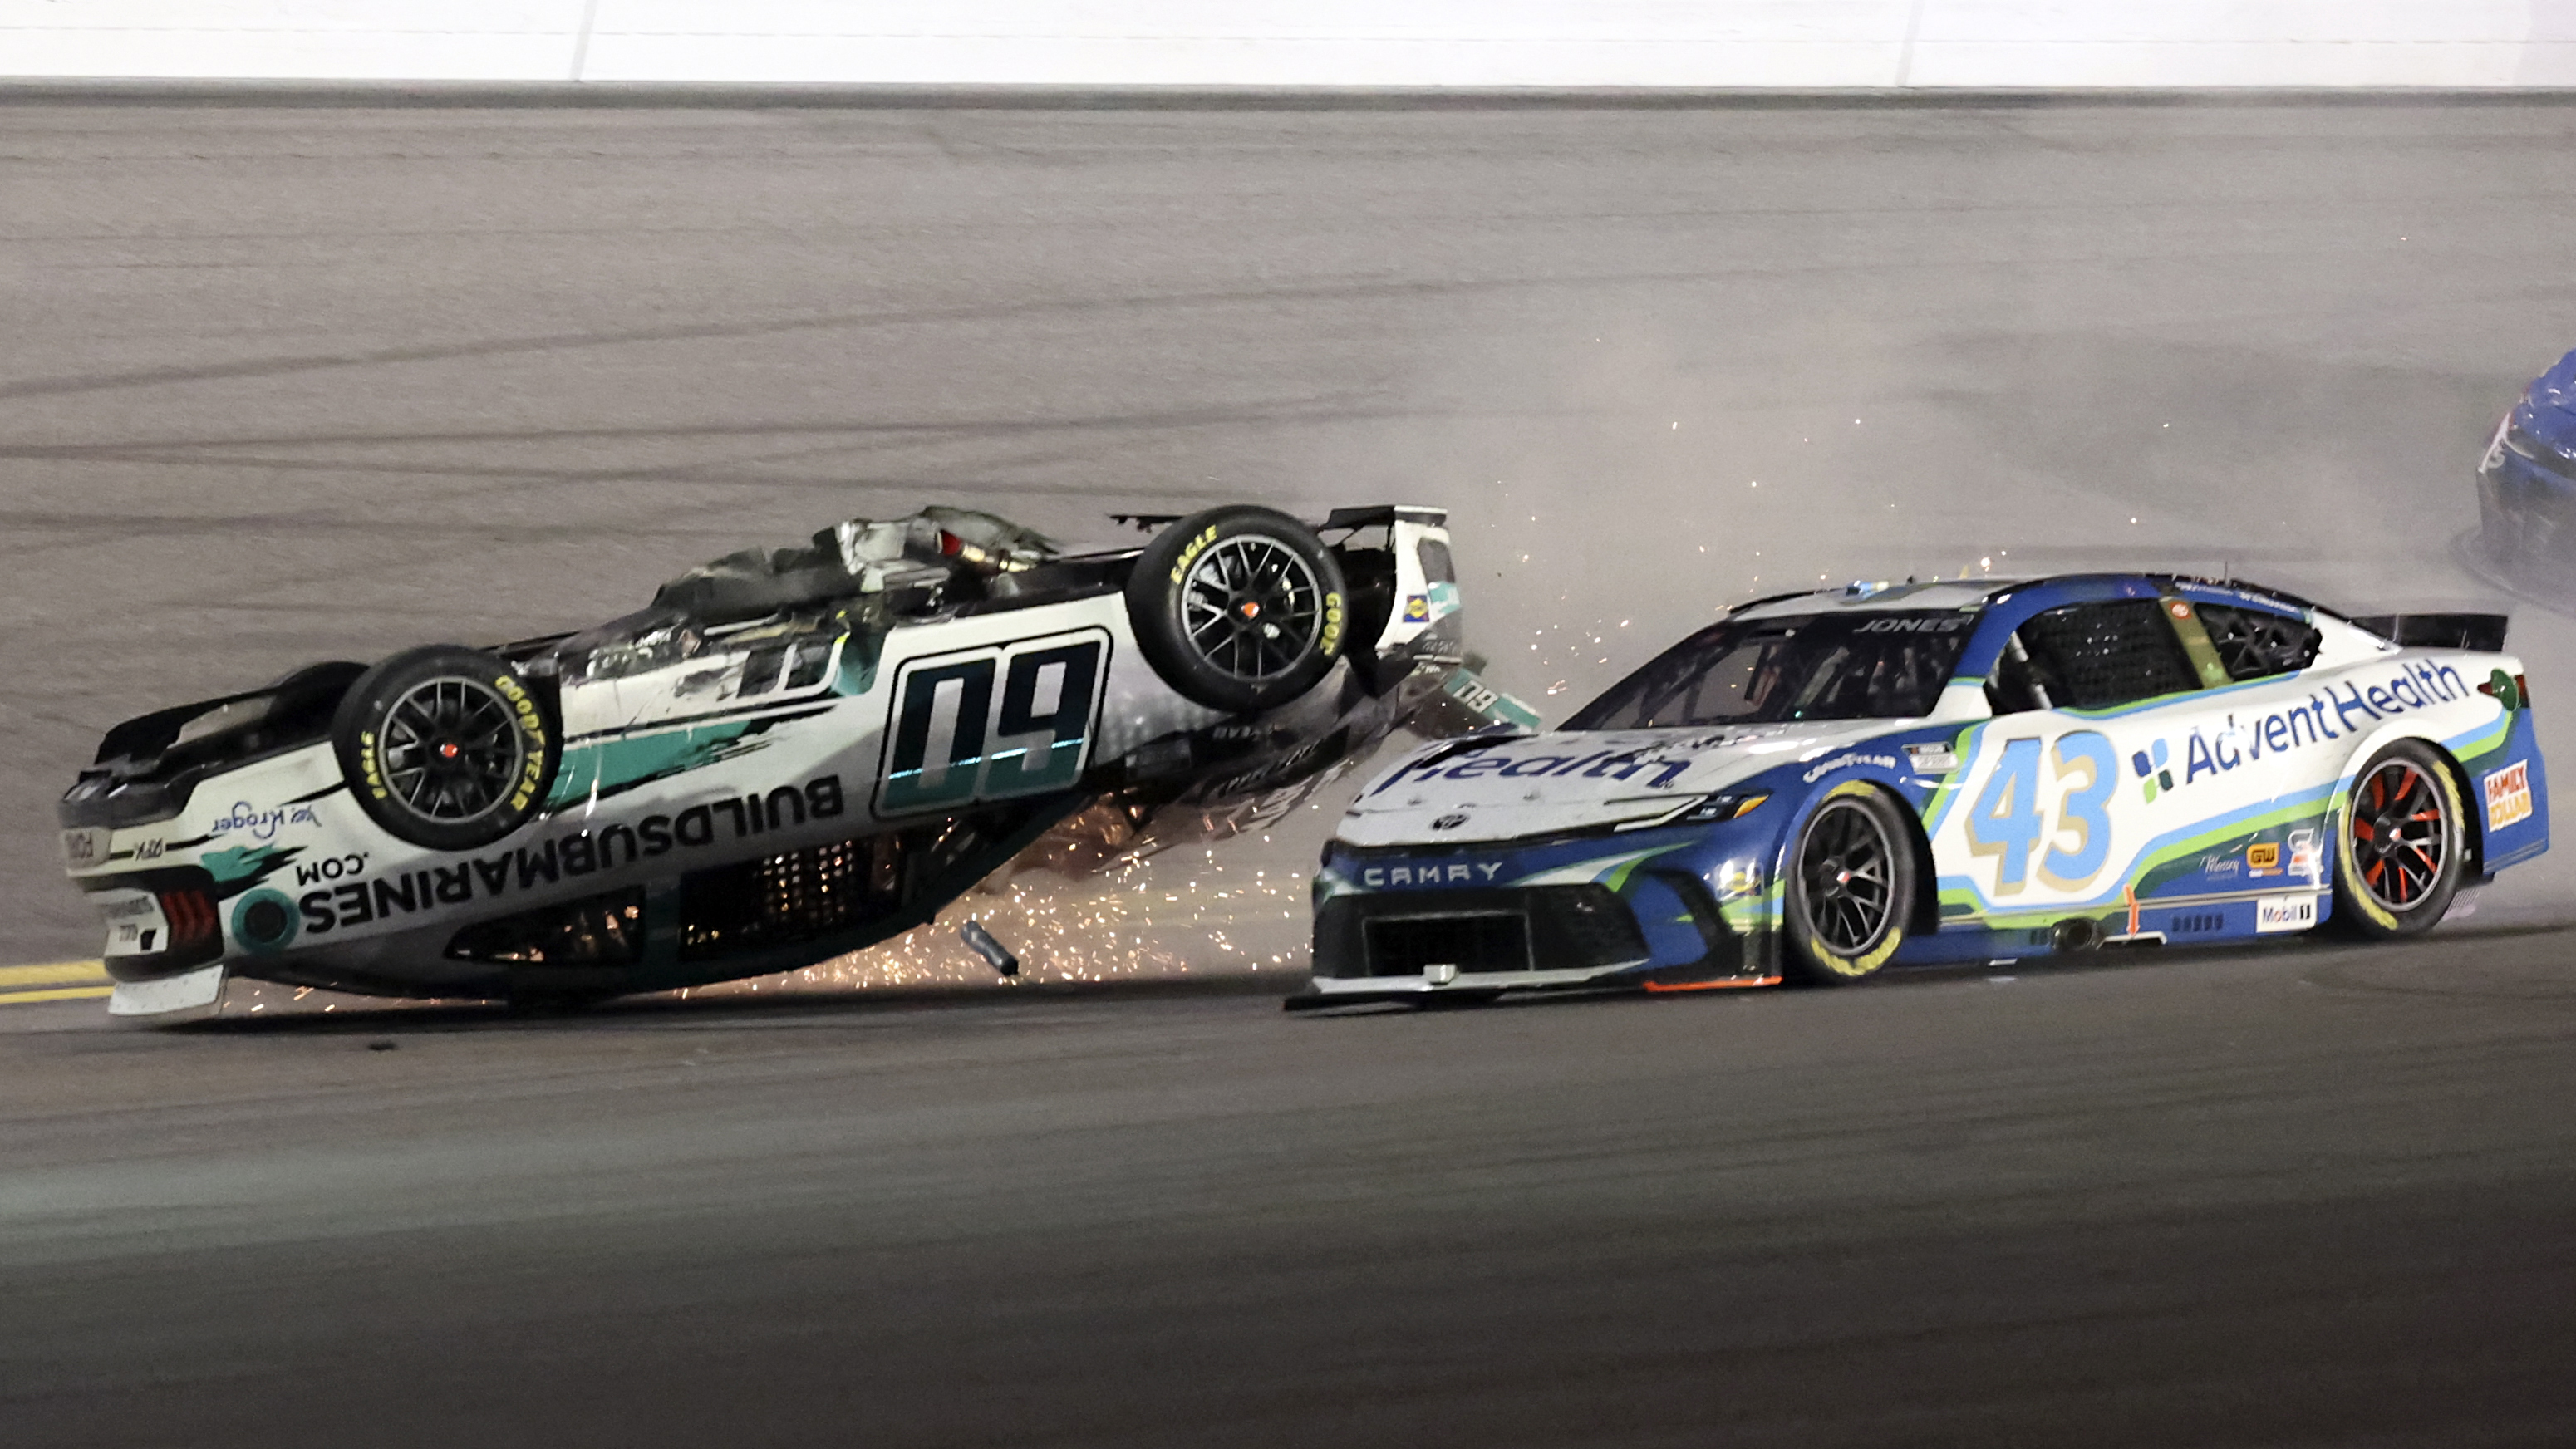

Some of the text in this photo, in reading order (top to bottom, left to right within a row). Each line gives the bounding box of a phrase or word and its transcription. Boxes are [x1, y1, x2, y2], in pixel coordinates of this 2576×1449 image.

[1170, 524, 1217, 585] EAGLE
[1852, 617, 1962, 634] JONES
[212, 801, 284, 840] Kroger
[1965, 731, 2117, 897] 43
[296, 852, 370, 887] .COM
[299, 774, 845, 935] BUILDSUBMARINES
[1364, 862, 1503, 886] CAMRY
[2262, 904, 2298, 924] Mobil
